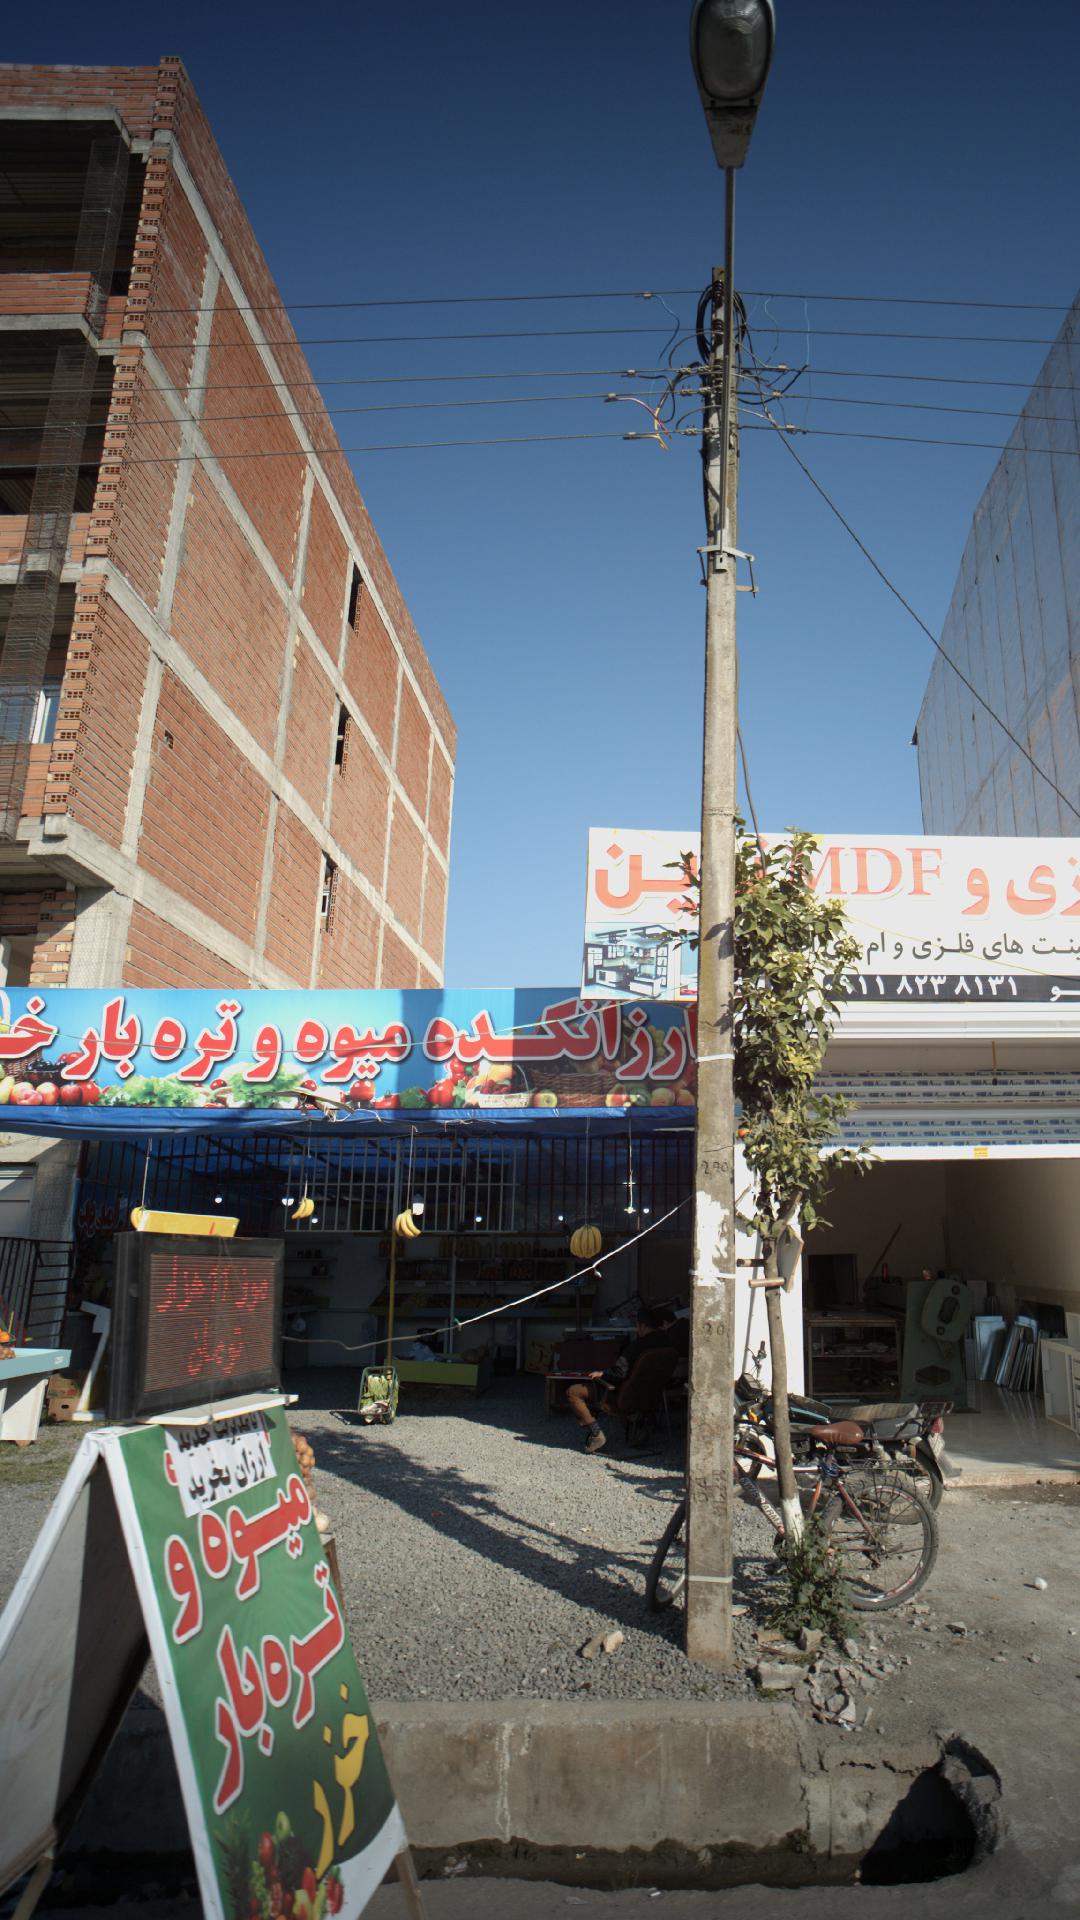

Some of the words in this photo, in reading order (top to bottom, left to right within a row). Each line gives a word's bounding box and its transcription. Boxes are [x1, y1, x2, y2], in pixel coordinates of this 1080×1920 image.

[785, 846, 943, 896] MDF
[961, 867, 990, 915] و
[866, 931, 885, 966] ام
[982, 932, 1025, 960] های
[896, 975, 946, 996] ۸۲۳
[954, 975, 1018, 996] ۸۱۳۱
[60, 996, 142, 1081] بار
[150, 999, 243, 1083] تره
[243, 1023, 283, 1083] و
[296, 1017, 412, 1084] میوه
[235, 1439, 268, 1488] ارزان
[198, 1473, 312, 1602] میوه
[164, 1534, 203, 1645] و
[259, 1559, 347, 1731] تره
[213, 1623, 274, 1816] بار
